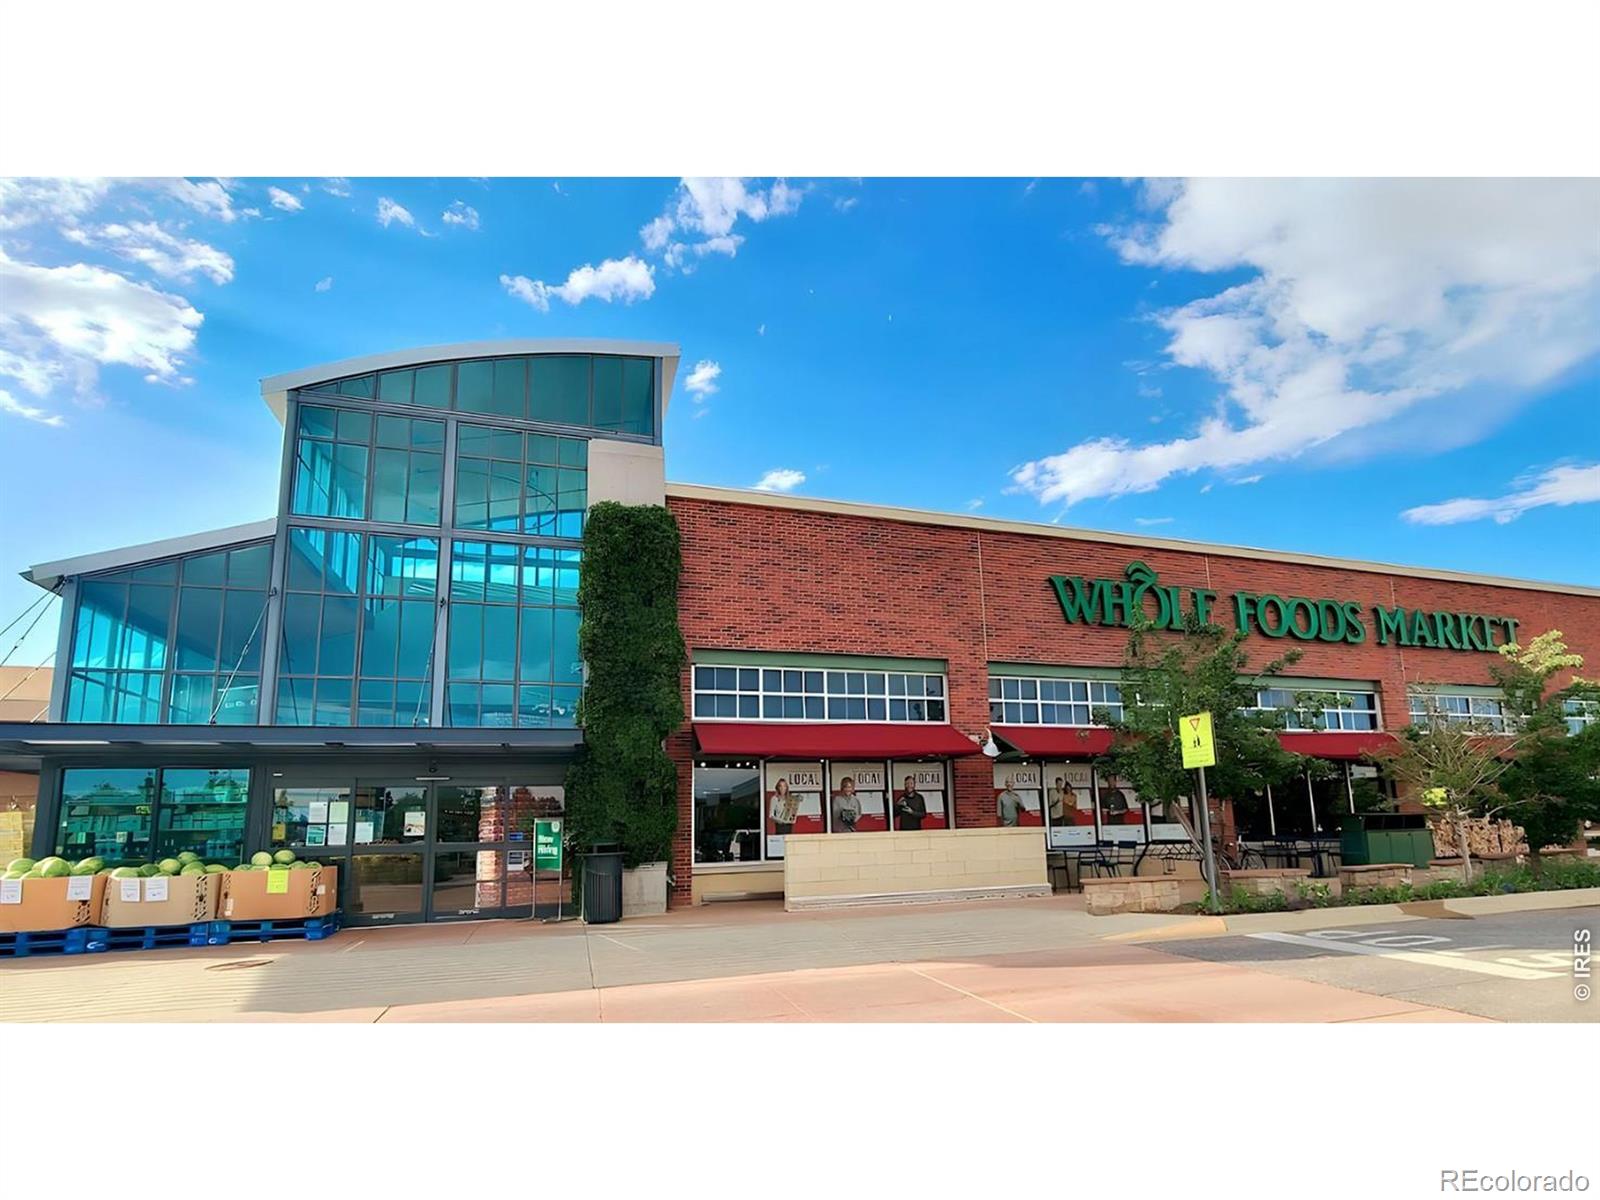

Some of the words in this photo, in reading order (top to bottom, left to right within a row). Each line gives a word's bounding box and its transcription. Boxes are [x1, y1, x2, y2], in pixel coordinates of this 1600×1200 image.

[1049, 560, 1217, 631] WHOLE
[1233, 590, 1367, 644] FOODS
[1374, 604, 1520, 651] MARKET
[788, 771, 821, 786] LOCAL
